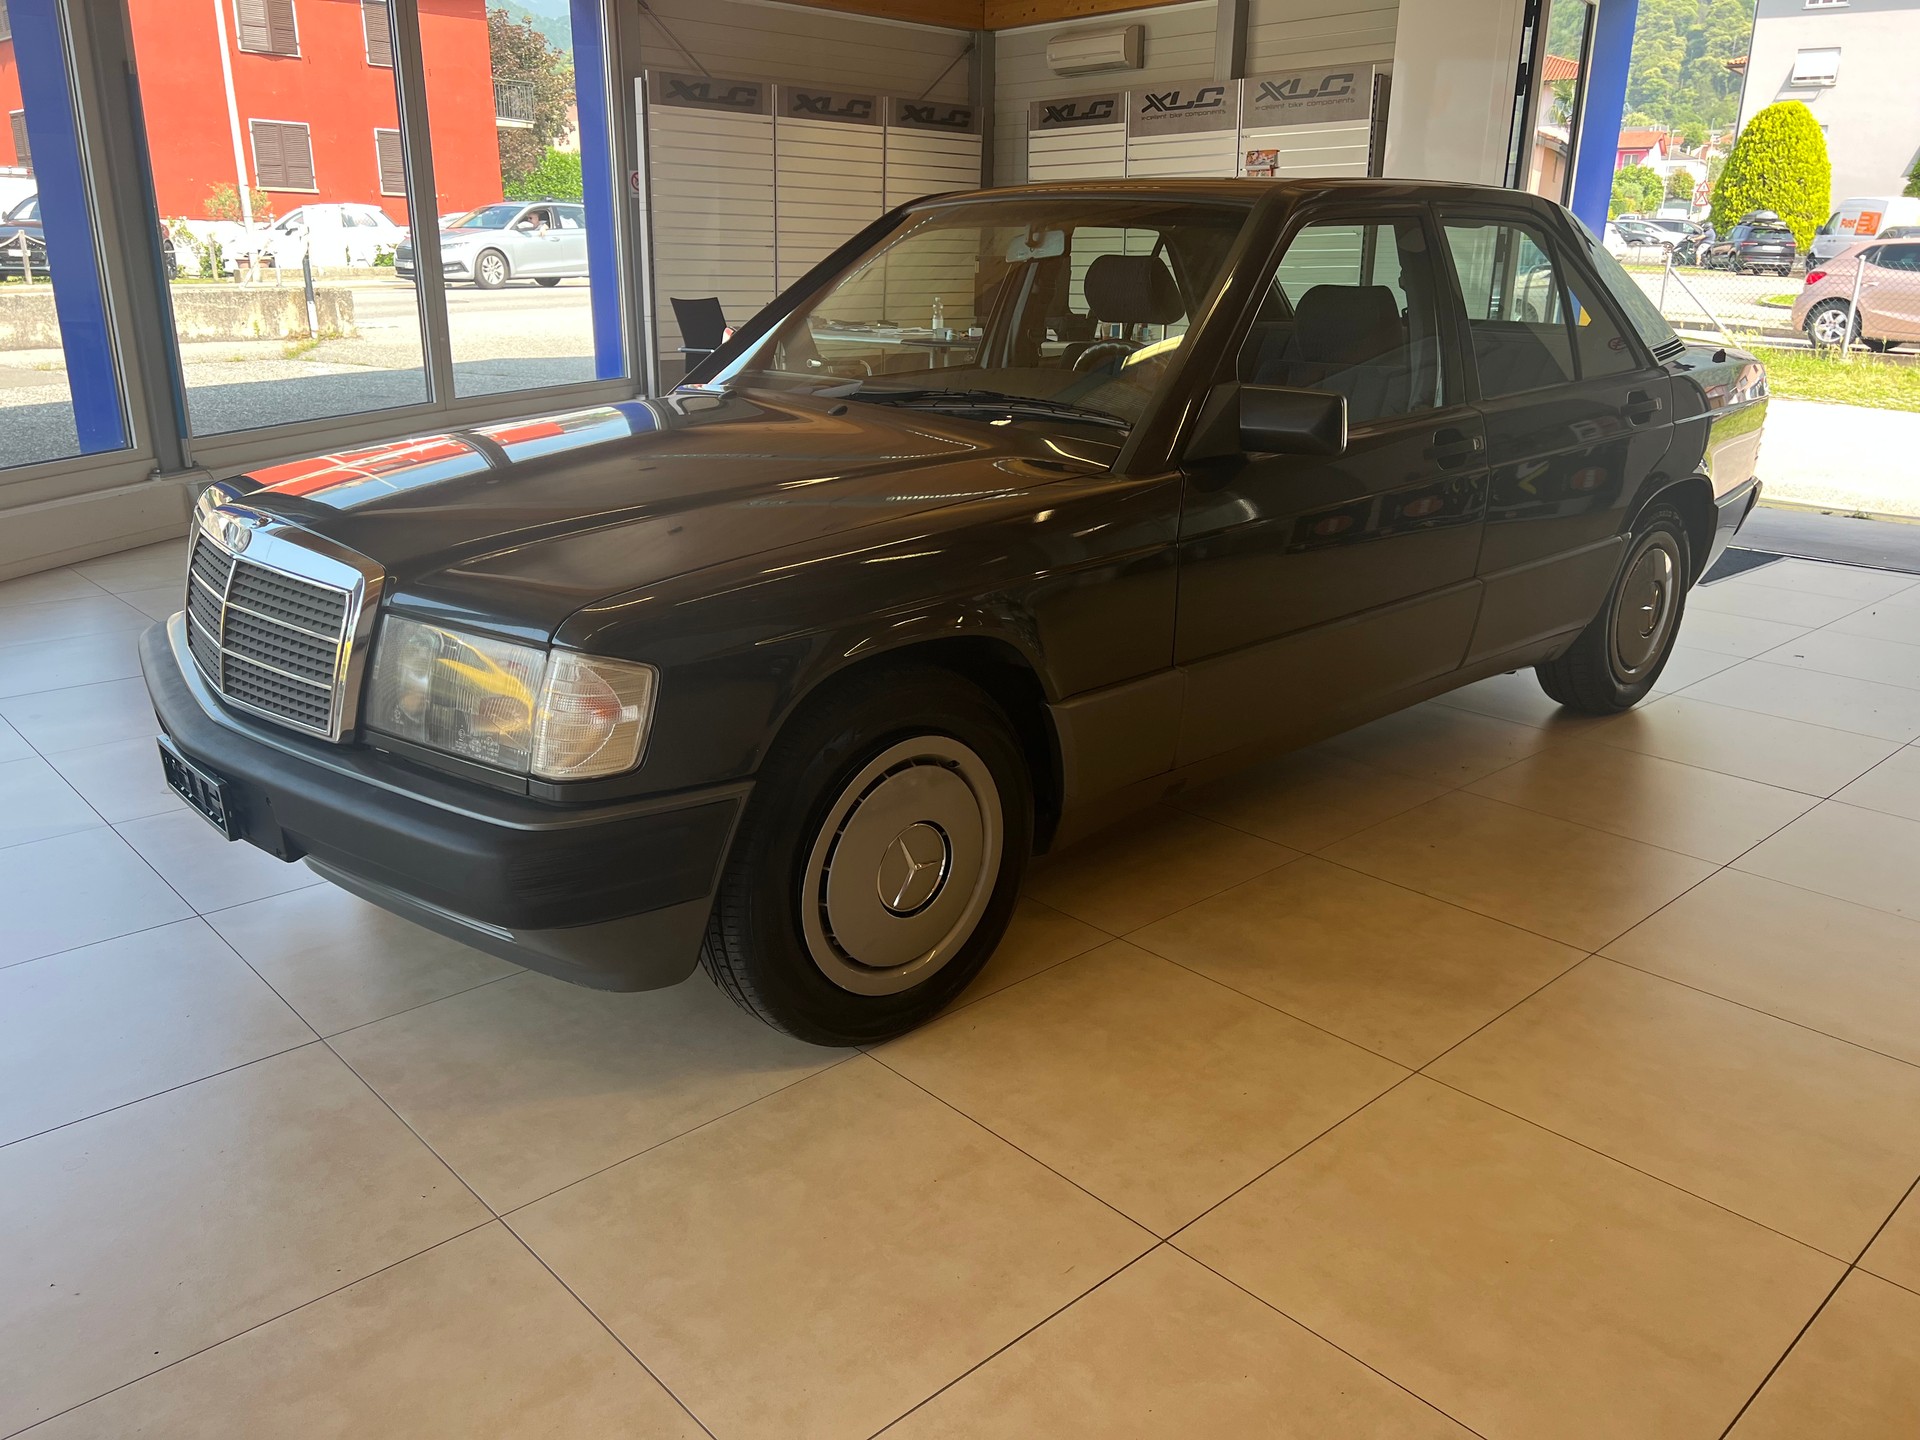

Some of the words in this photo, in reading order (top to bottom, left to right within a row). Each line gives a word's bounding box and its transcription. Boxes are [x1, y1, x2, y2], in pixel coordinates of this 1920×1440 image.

[666, 79, 757, 107] XLC
[1141, 86, 1225, 113] XLC
[1255, 73, 1354, 103] XLC
[793, 94, 872, 119] XLC
[1042, 100, 1114, 123] XLC
[1185, 109, 1226, 118] components
[1288, 101, 1303, 109] bike
[1306, 97, 1355, 107] components
[901, 104, 971, 128] XLC
